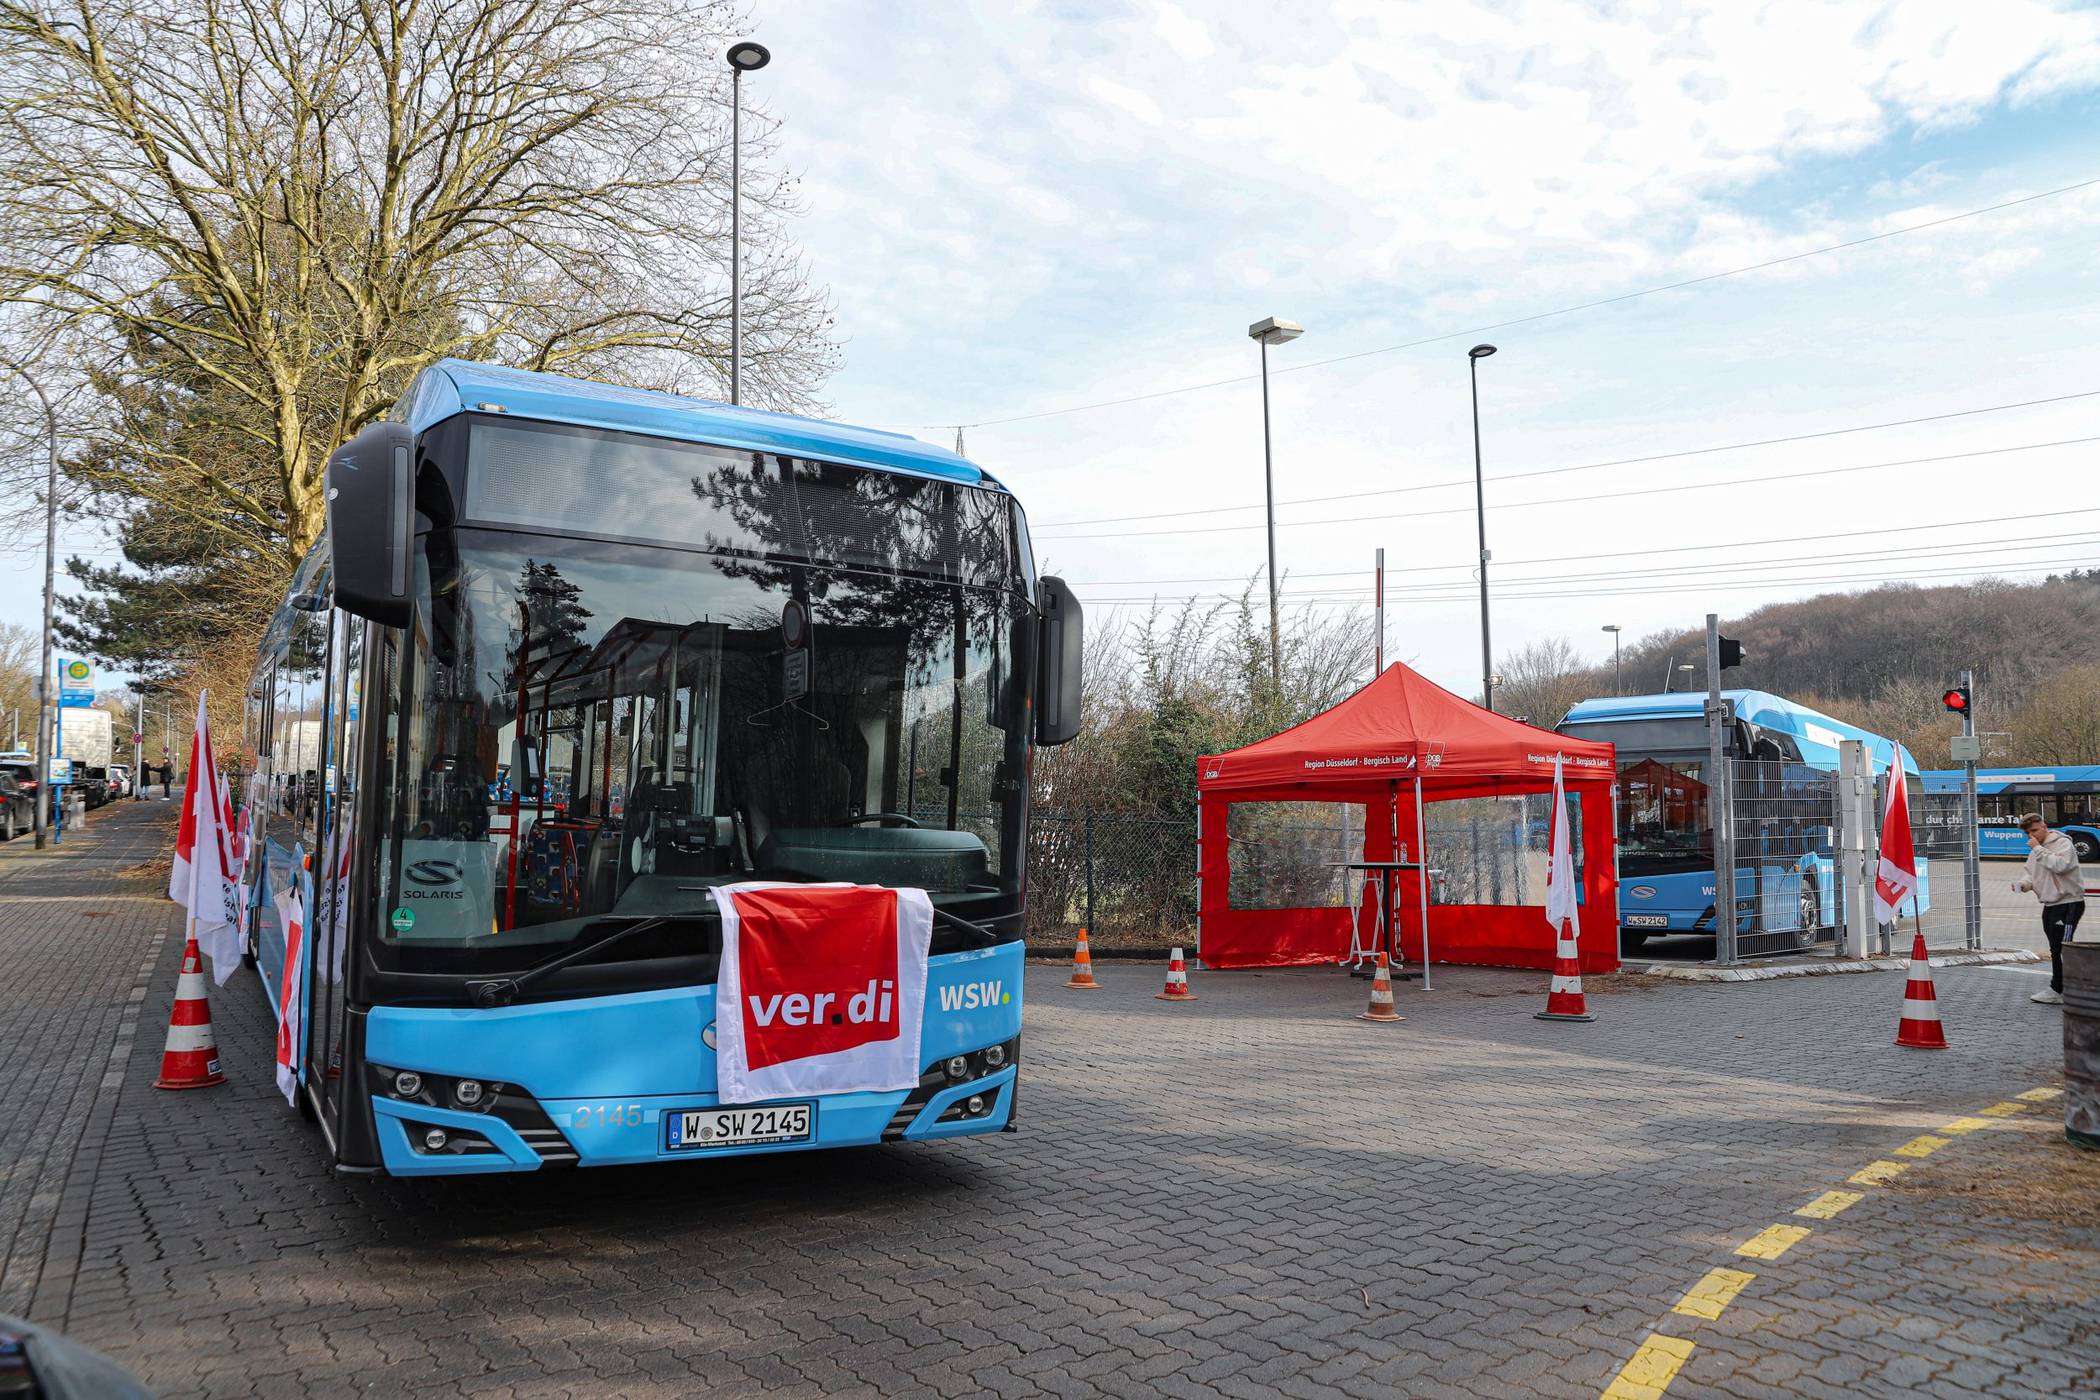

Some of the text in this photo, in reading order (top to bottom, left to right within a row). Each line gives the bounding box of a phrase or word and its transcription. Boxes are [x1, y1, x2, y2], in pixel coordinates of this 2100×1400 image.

[1304, 760, 1325, 770] Region
[1326, 757, 1358, 767] Düsseldorf
[1363, 756, 1391, 767] Bergisch
[1392, 755, 1408, 764] Land
[1527, 754, 1546, 764] Region
[1577, 757, 1597, 767] Bergisch
[1977, 816, 2004, 824] anze
[403, 891, 464, 899] SOLARIS
[400, 908, 407, 920] 4
[1648, 917, 1666, 925] 2142
[748, 979, 893, 1027] ver.di
[576, 1104, 641, 1129] 2145
[685, 1115, 700, 1139] W
[751, 1109, 807, 1135] 2145
